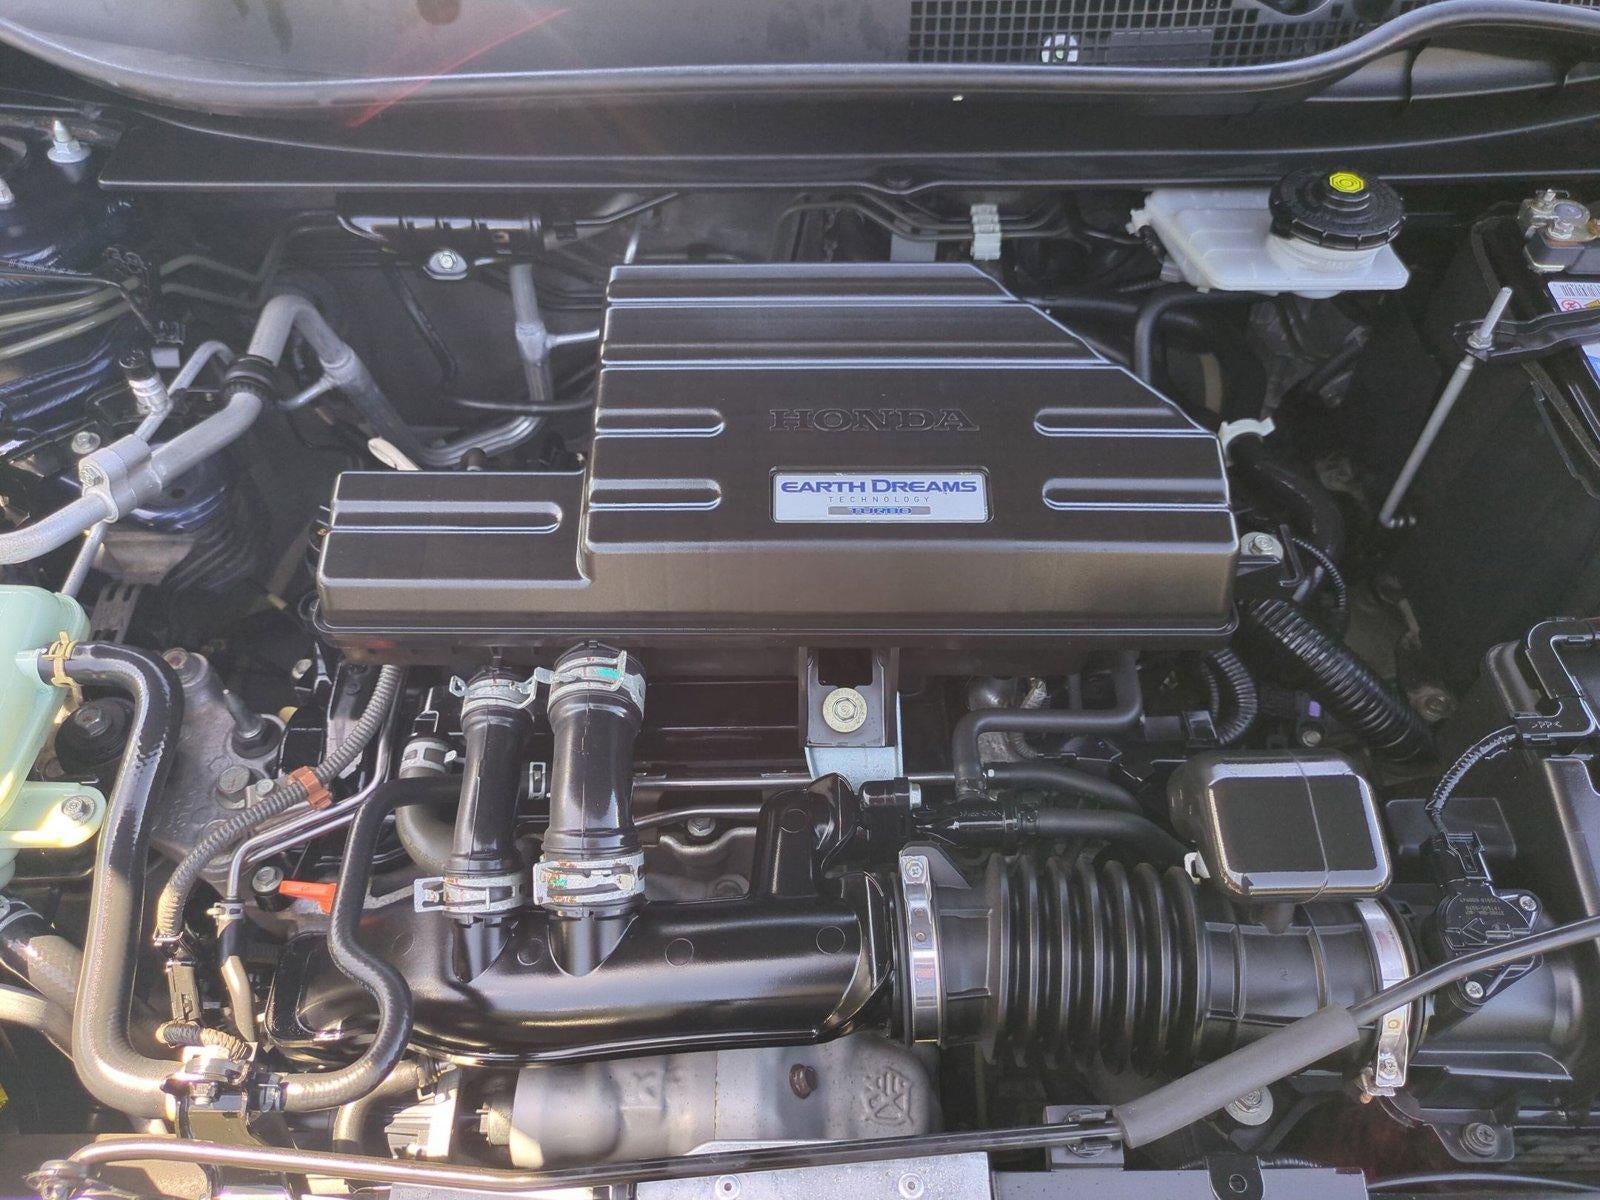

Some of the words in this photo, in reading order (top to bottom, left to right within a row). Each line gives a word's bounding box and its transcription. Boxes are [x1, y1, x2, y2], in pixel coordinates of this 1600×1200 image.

[769, 407, 979, 432] HONDA
[781, 480, 866, 493] EARTH
[870, 479, 978, 493] DREAMS
[828, 496, 930, 504] TECHNOLOGY
